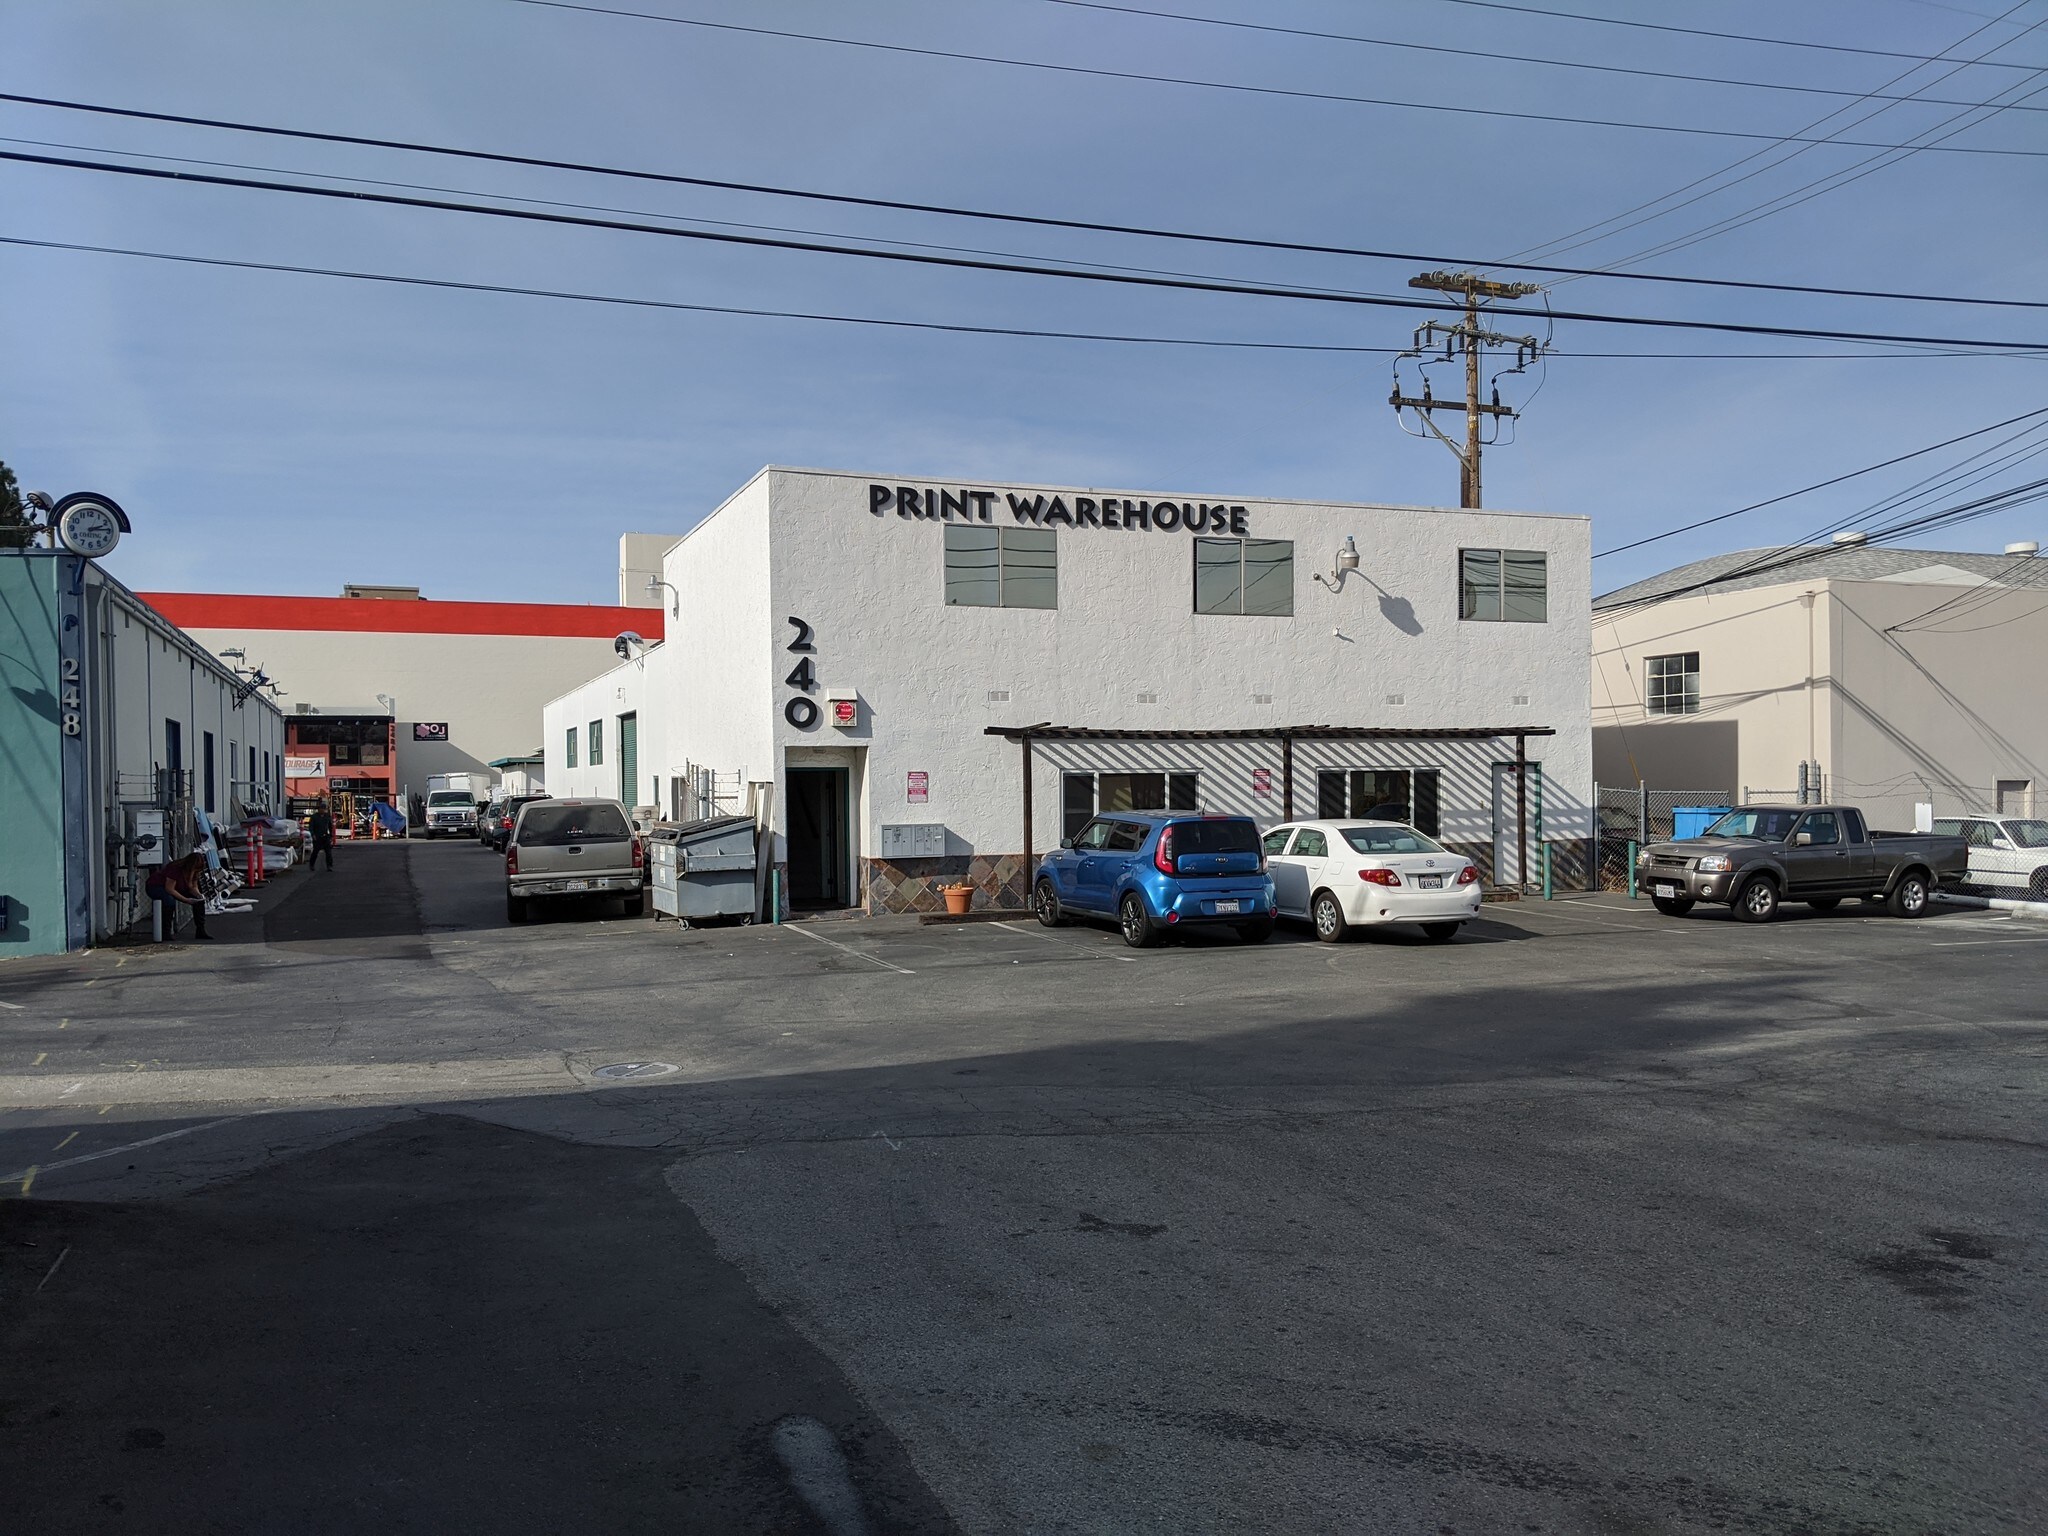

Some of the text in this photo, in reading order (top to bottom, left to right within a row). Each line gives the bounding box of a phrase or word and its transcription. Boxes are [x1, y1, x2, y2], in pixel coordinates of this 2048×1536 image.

[869, 484, 1247, 534] PRINT WAREHOUSE
[62, 658, 81, 736] 248
[238, 675, 262, 698] OFFICE
[785, 616, 817, 728] 240
[285, 760, 316, 769] OURAGE
